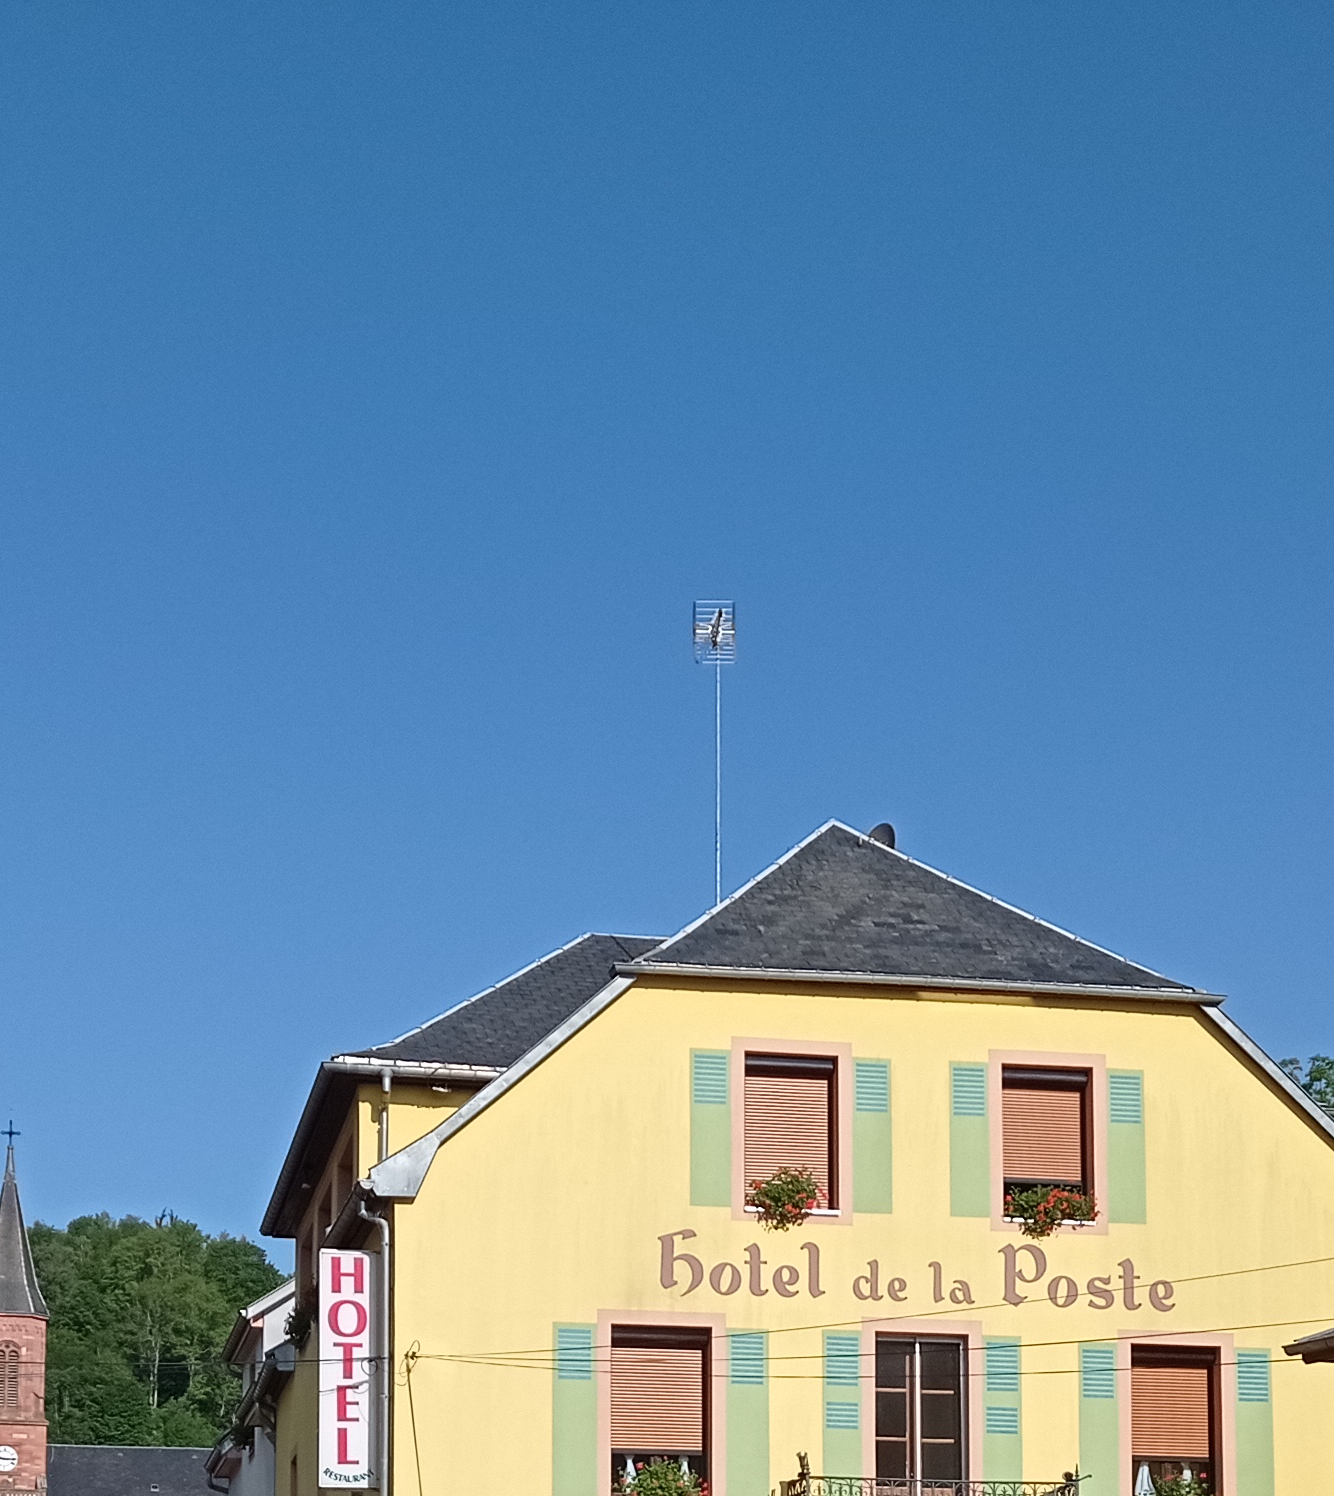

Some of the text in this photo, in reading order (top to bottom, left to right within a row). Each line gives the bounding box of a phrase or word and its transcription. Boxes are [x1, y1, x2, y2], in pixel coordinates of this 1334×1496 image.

[852, 1259, 909, 1302] de
[929, 1261, 975, 1305] la
[998, 1243, 1176, 1312] Poste
[328, 1256, 367, 1465] HOTEL
[323, 1467, 375, 1483] RESTAURANT
